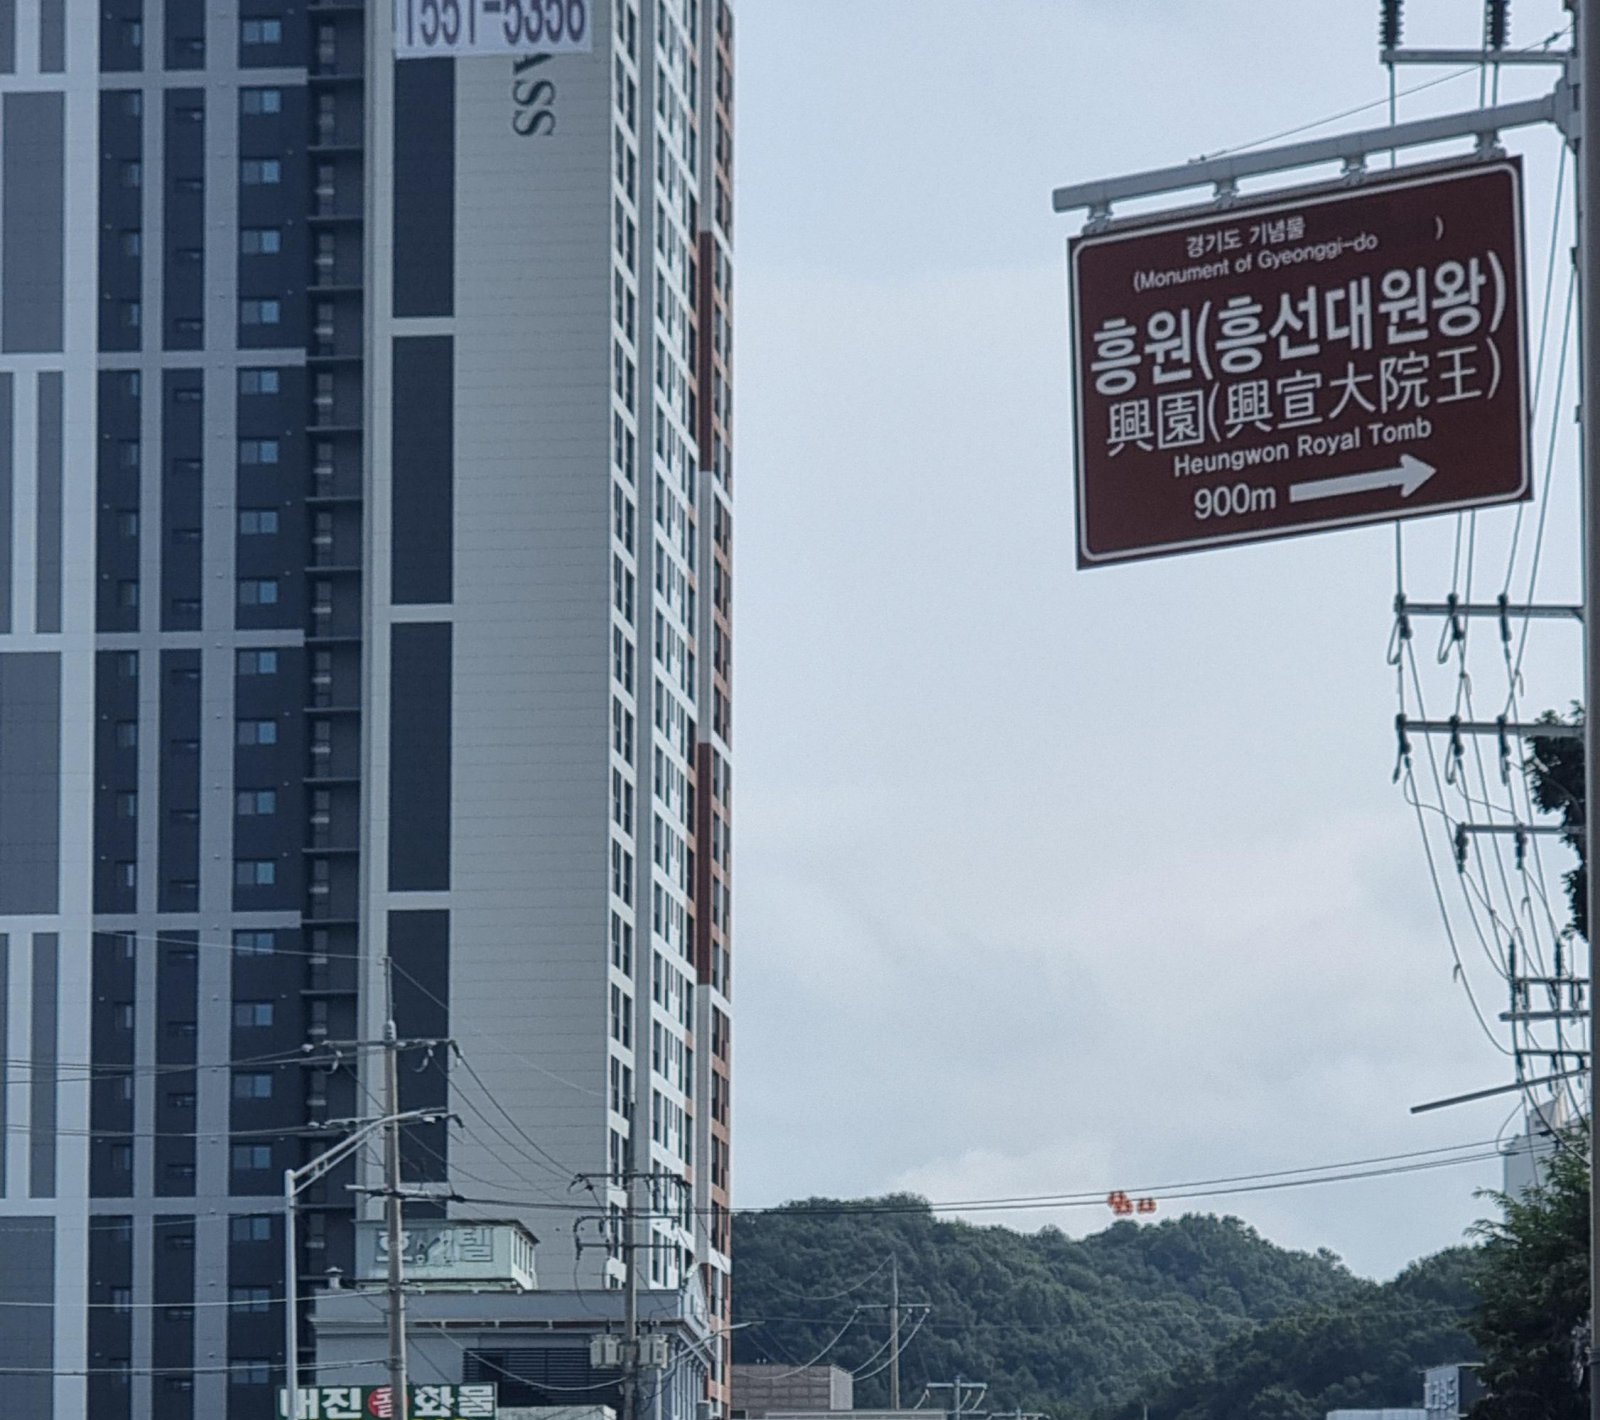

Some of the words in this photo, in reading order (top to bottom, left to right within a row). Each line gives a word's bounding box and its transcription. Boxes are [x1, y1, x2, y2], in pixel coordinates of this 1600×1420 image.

[1133, 261, 1230, 292] (Monument
[1235, 252, 1254, 272] of
[1258, 232, 1379, 270] Gyeonggi-do
[1186, 229, 1243, 259] 경기도
[1250, 216, 1306, 246] 기념물
[1090, 251, 1506, 396] 흥원(흥선대원왕)
[1106, 337, 1502, 457] 興園(興宣大院王)
[1173, 441, 1290, 478] Heungwon
[1297, 427, 1361, 457] Royal
[1369, 416, 1433, 447] Tomb
[1194, 482, 1277, 520] 900m
